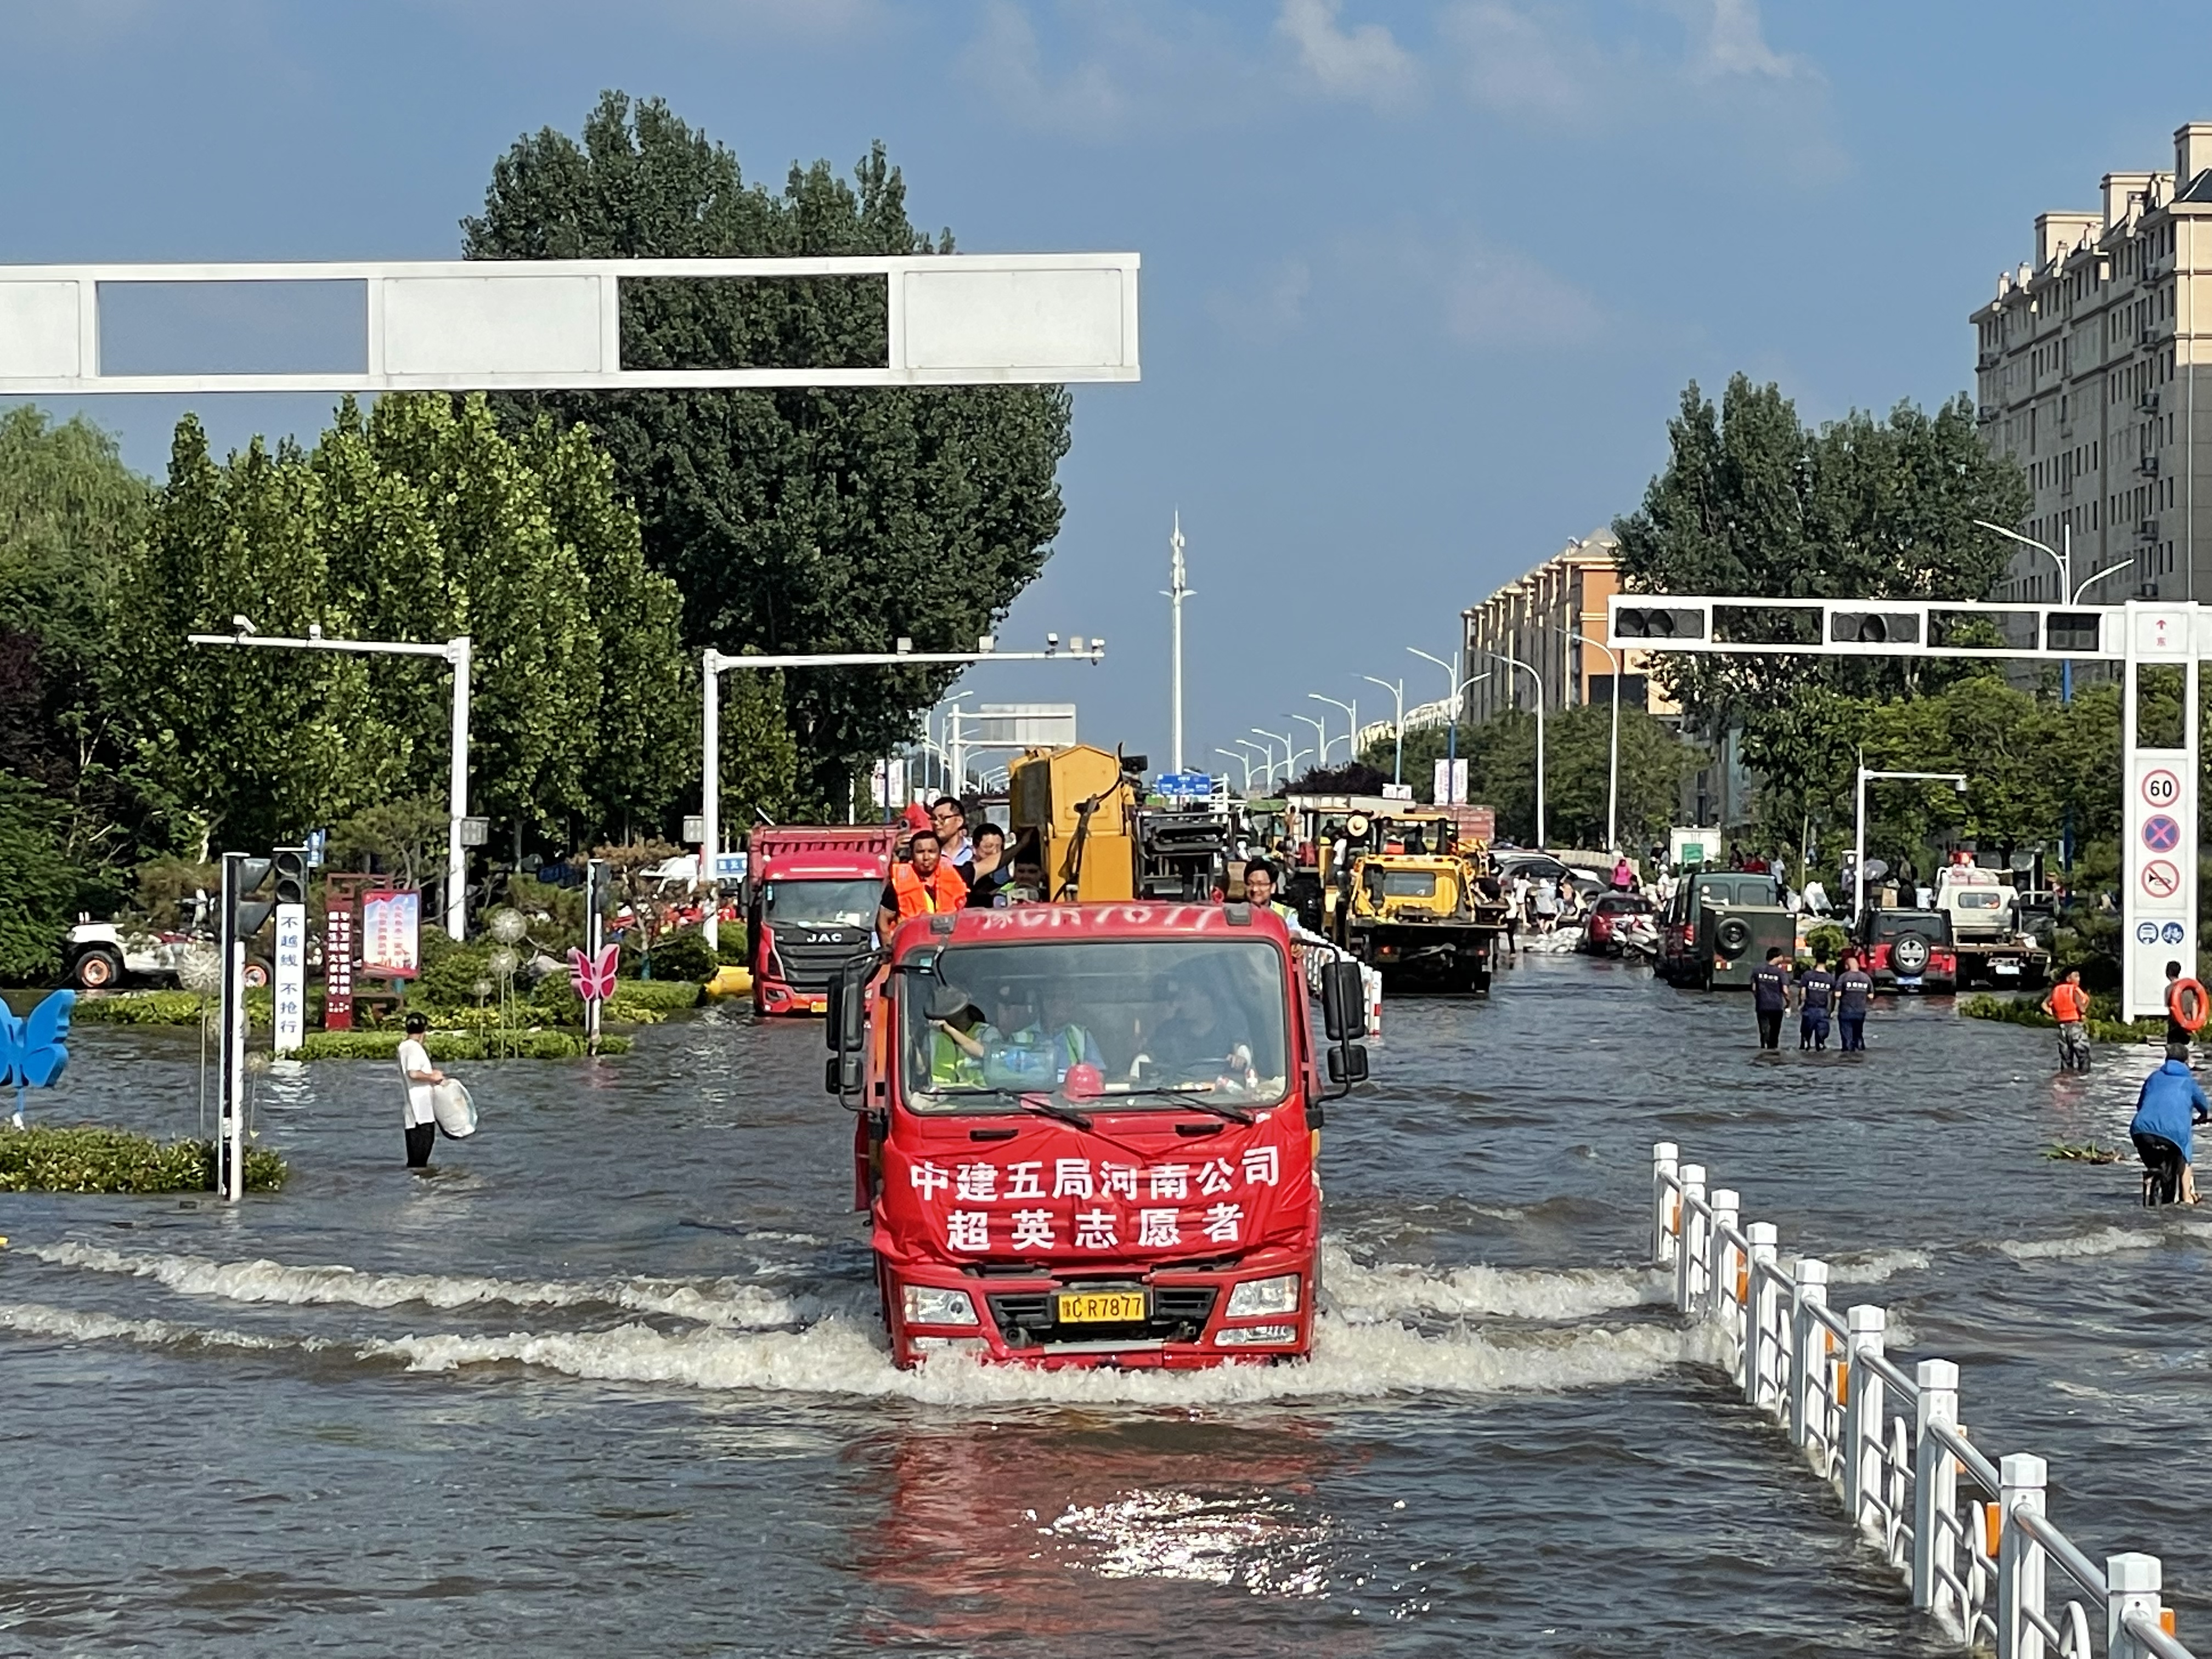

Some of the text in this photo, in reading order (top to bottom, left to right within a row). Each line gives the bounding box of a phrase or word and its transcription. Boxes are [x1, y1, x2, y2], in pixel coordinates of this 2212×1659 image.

[2151, 780, 2172, 798] 60
[806, 933, 842, 943] JAC
[280, 983, 298, 1033] 不抢行
[910, 1145, 1279, 1202] 中建五局河南公司
[946, 1202, 1244, 1251] 超英志愿者
